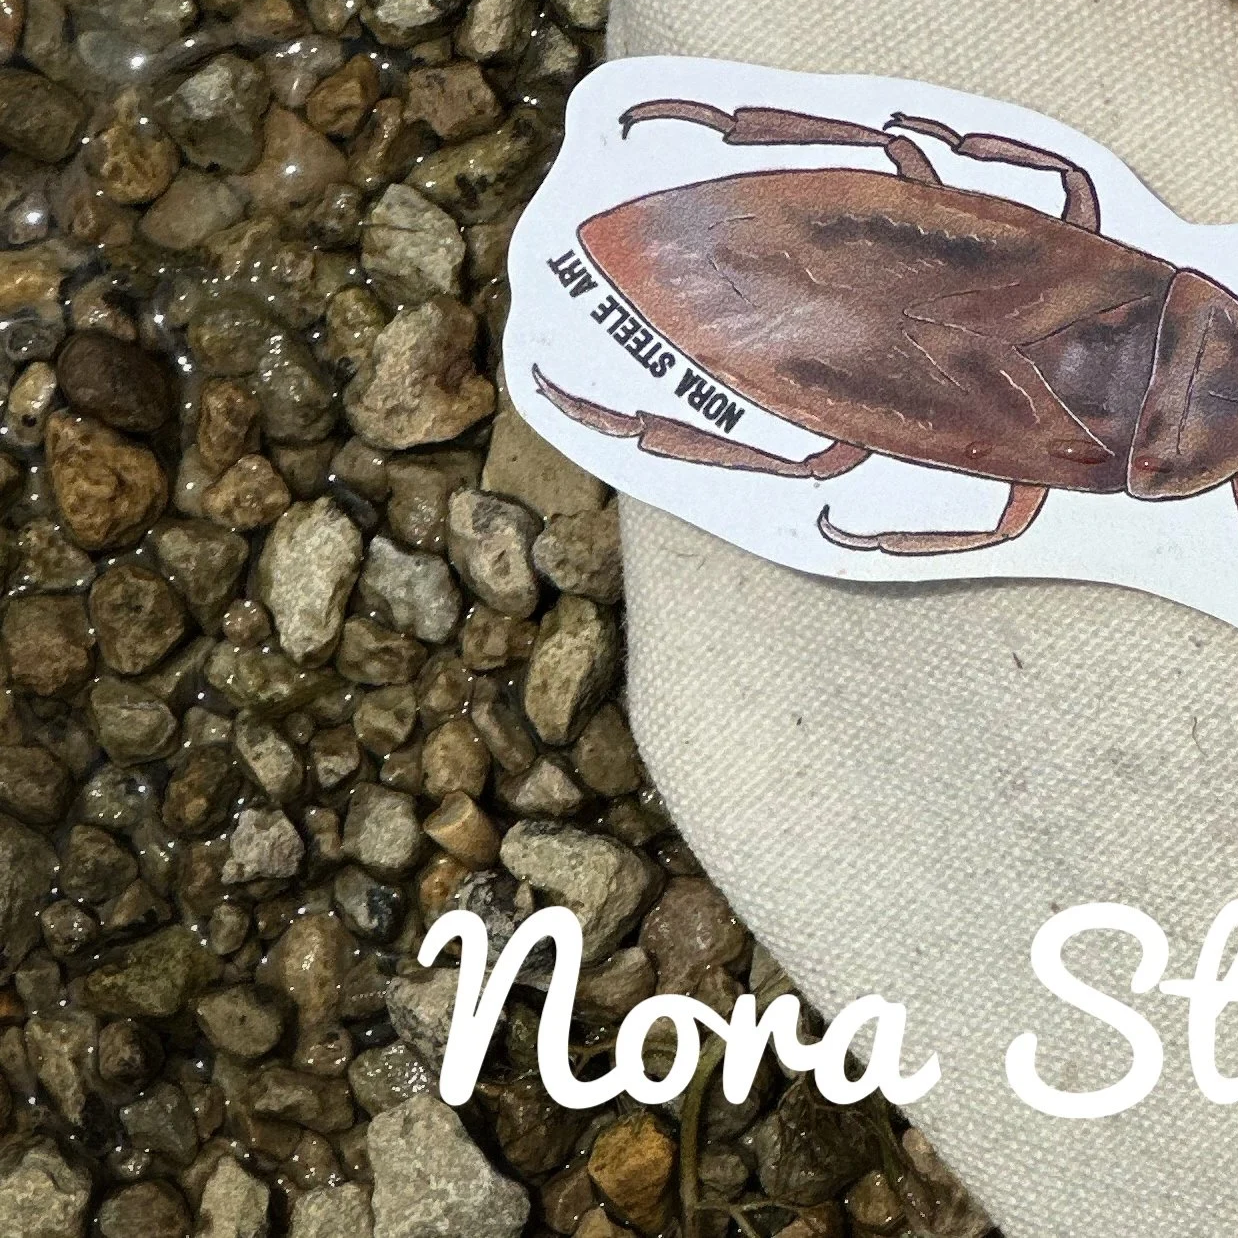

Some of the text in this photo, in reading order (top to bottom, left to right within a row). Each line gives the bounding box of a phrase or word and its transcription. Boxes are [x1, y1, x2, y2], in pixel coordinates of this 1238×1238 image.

[546, 249, 746, 434] NORA STEELE ART
